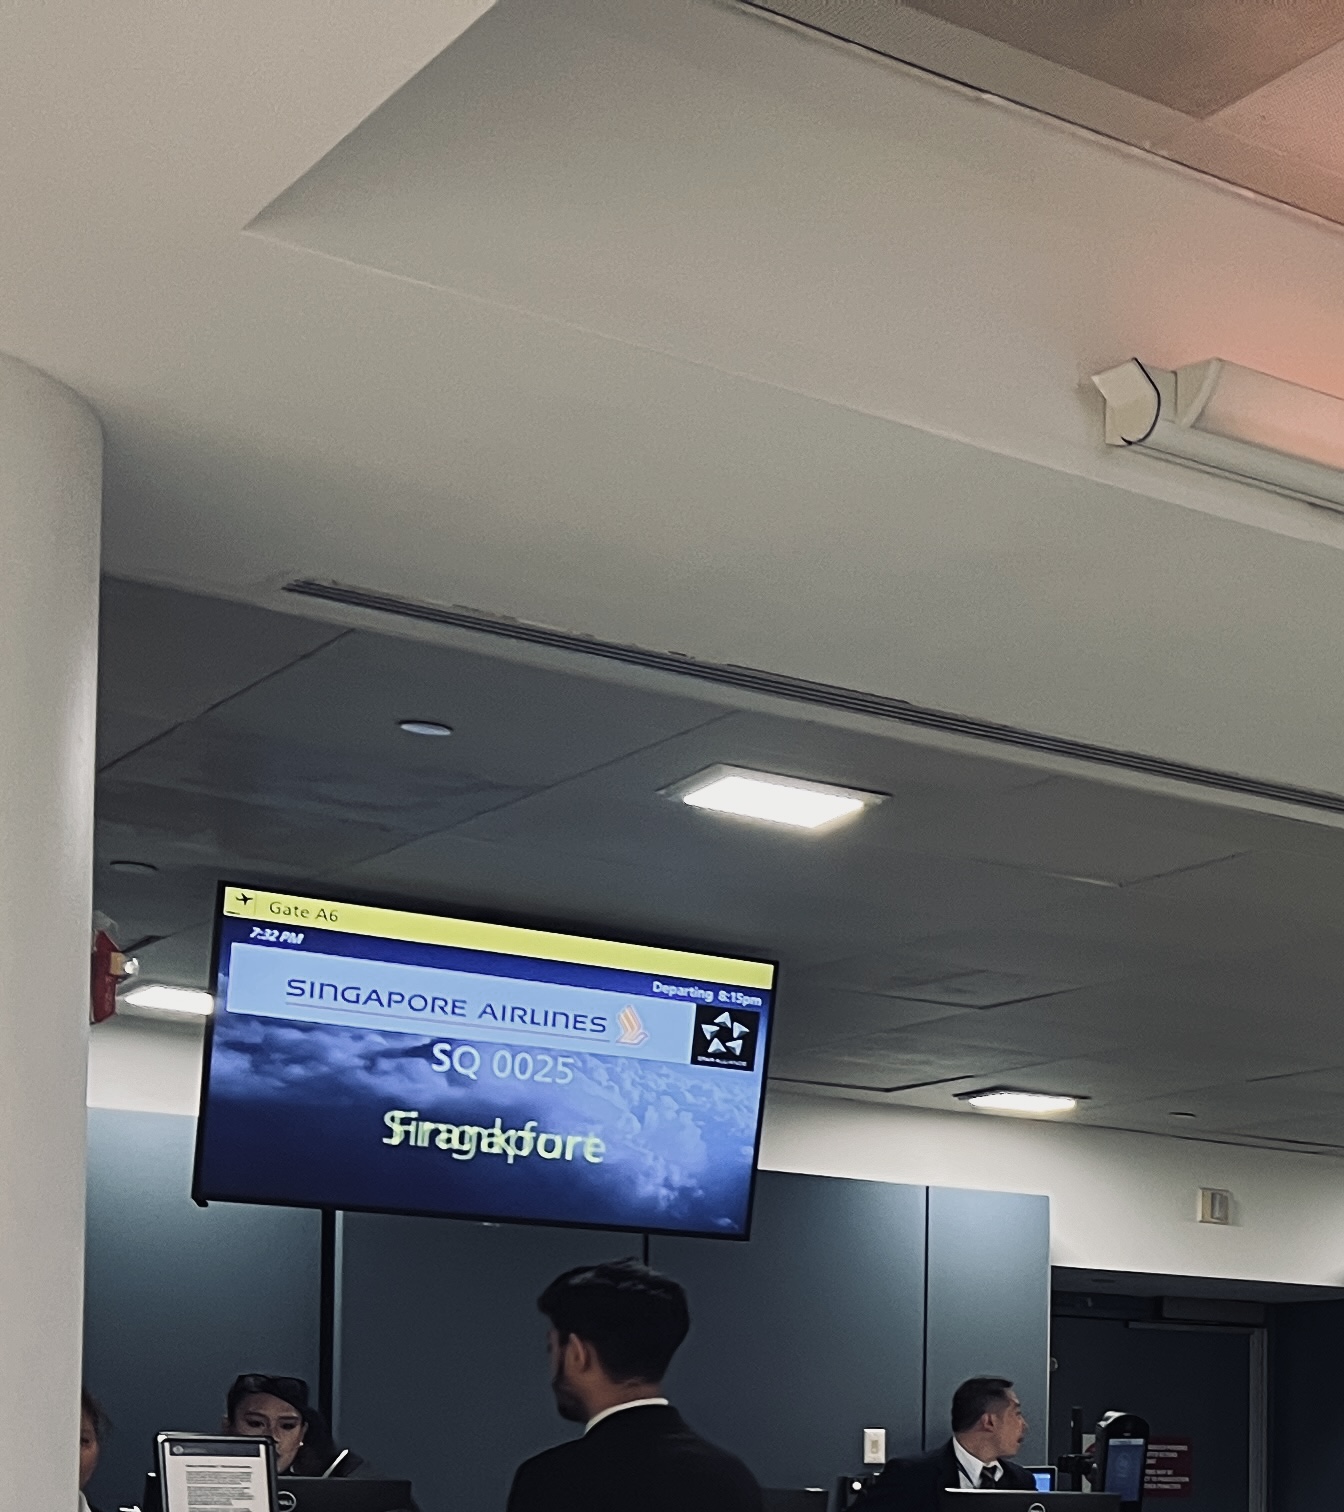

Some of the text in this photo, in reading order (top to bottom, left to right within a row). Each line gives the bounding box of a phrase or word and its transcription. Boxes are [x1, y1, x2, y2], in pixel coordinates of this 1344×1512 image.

[269, 901, 339, 922] Gate A6
[249, 926, 305, 944] 7:32 PM
[285, 979, 608, 1034] SINGAPORE AIRLINES
[652, 981, 762, 1007] Departing 8:15pm
[431, 1042, 576, 1085] SQ 0025
